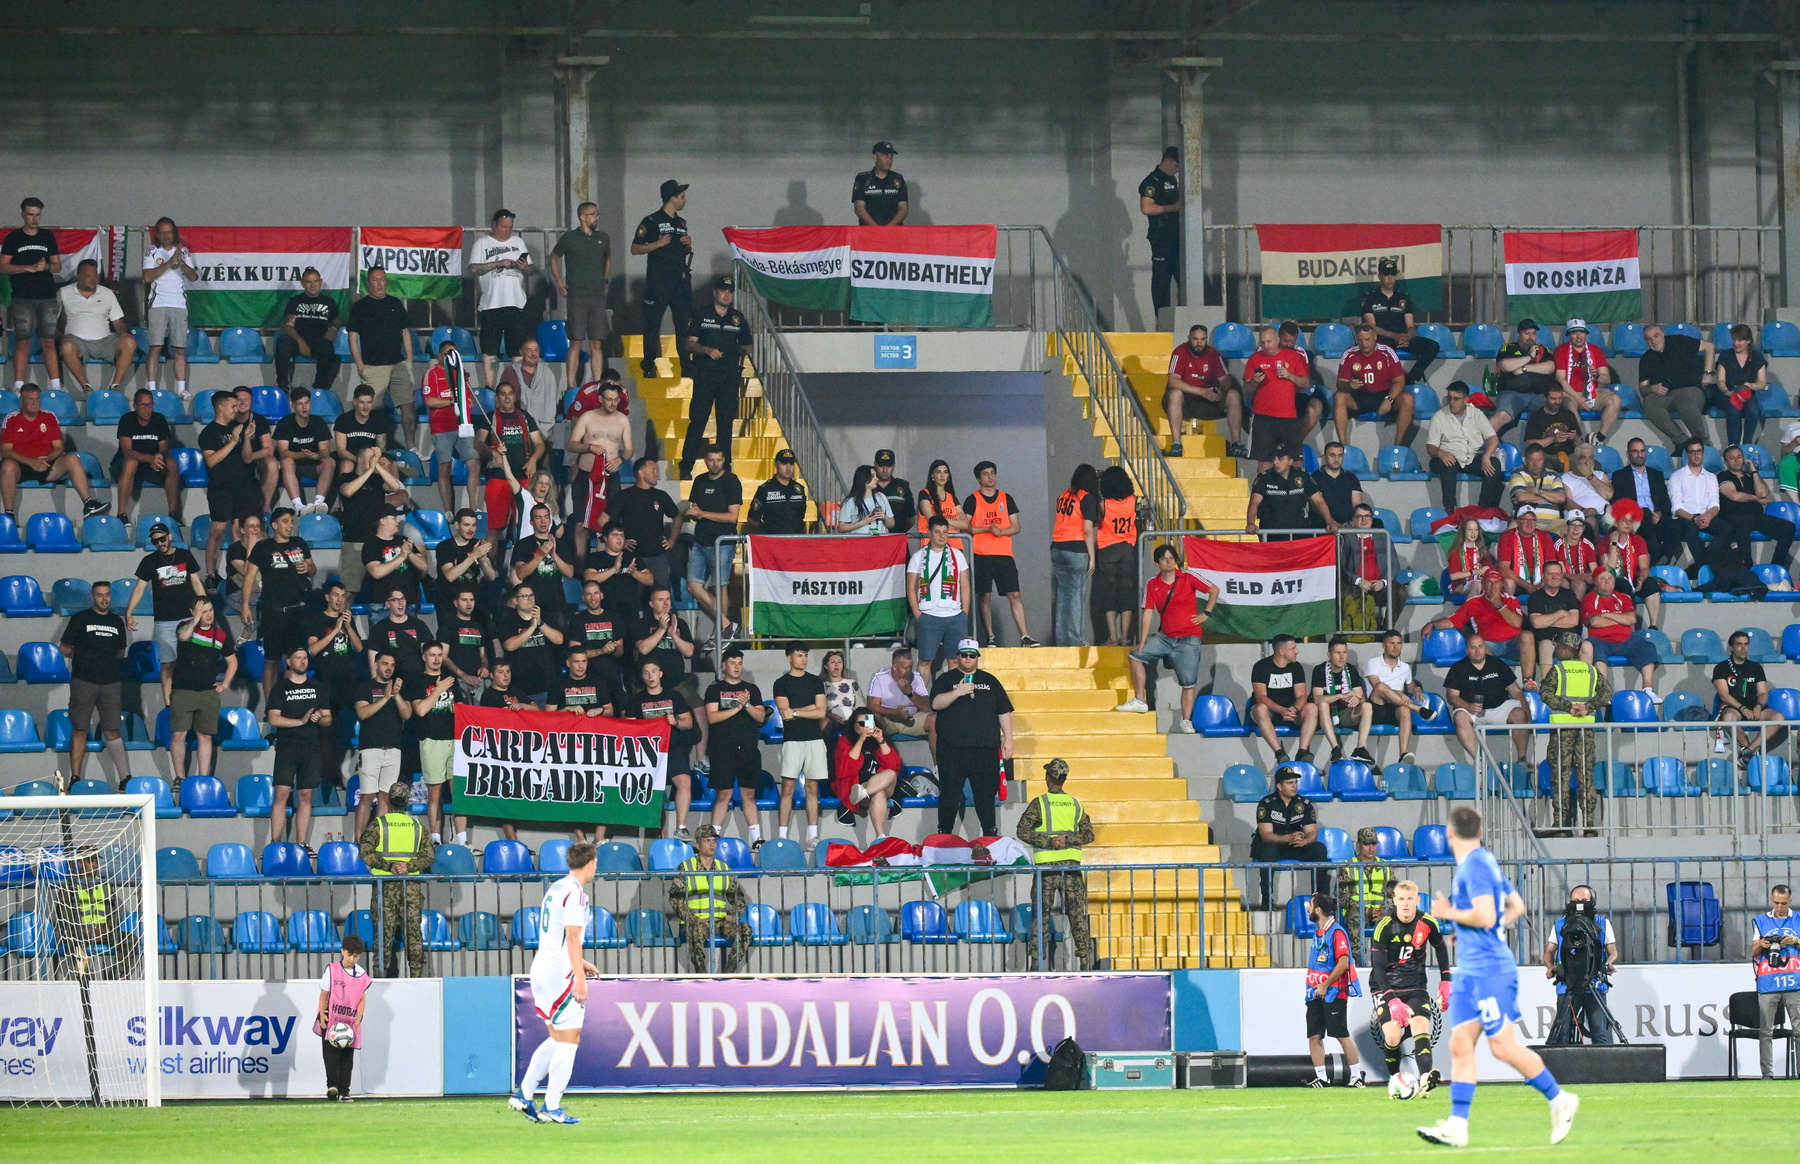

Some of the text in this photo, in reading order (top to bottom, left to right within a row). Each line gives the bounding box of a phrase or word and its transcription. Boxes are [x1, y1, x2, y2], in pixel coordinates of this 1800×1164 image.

[363, 246, 449, 274] KAPOSVÁR
[195, 263, 314, 281] ZÉKKUTA
[851, 259, 992, 286] SZOMBATHELY
[902, 345, 912, 359] 3
[1364, 372, 1375, 384] 10
[1112, 517, 1132, 534] 121
[792, 579, 863, 595] PÁSZTORI
[1226, 578, 1303, 595] ÉLD ÁT!
[286, 694, 317, 702] ARMOUR
[461, 725, 661, 768] CARPATHIAN
[464, 762, 654, 805] BRIGADE '09
[1399, 946, 1414, 960] 12
[1773, 975, 1796, 988] 115
[1373, 993, 1386, 1009] 12
[1478, 996, 1502, 1023] 20
[615, 1000, 950, 1068] XIRDALAN
[127, 1052, 269, 1074] wst airlines
